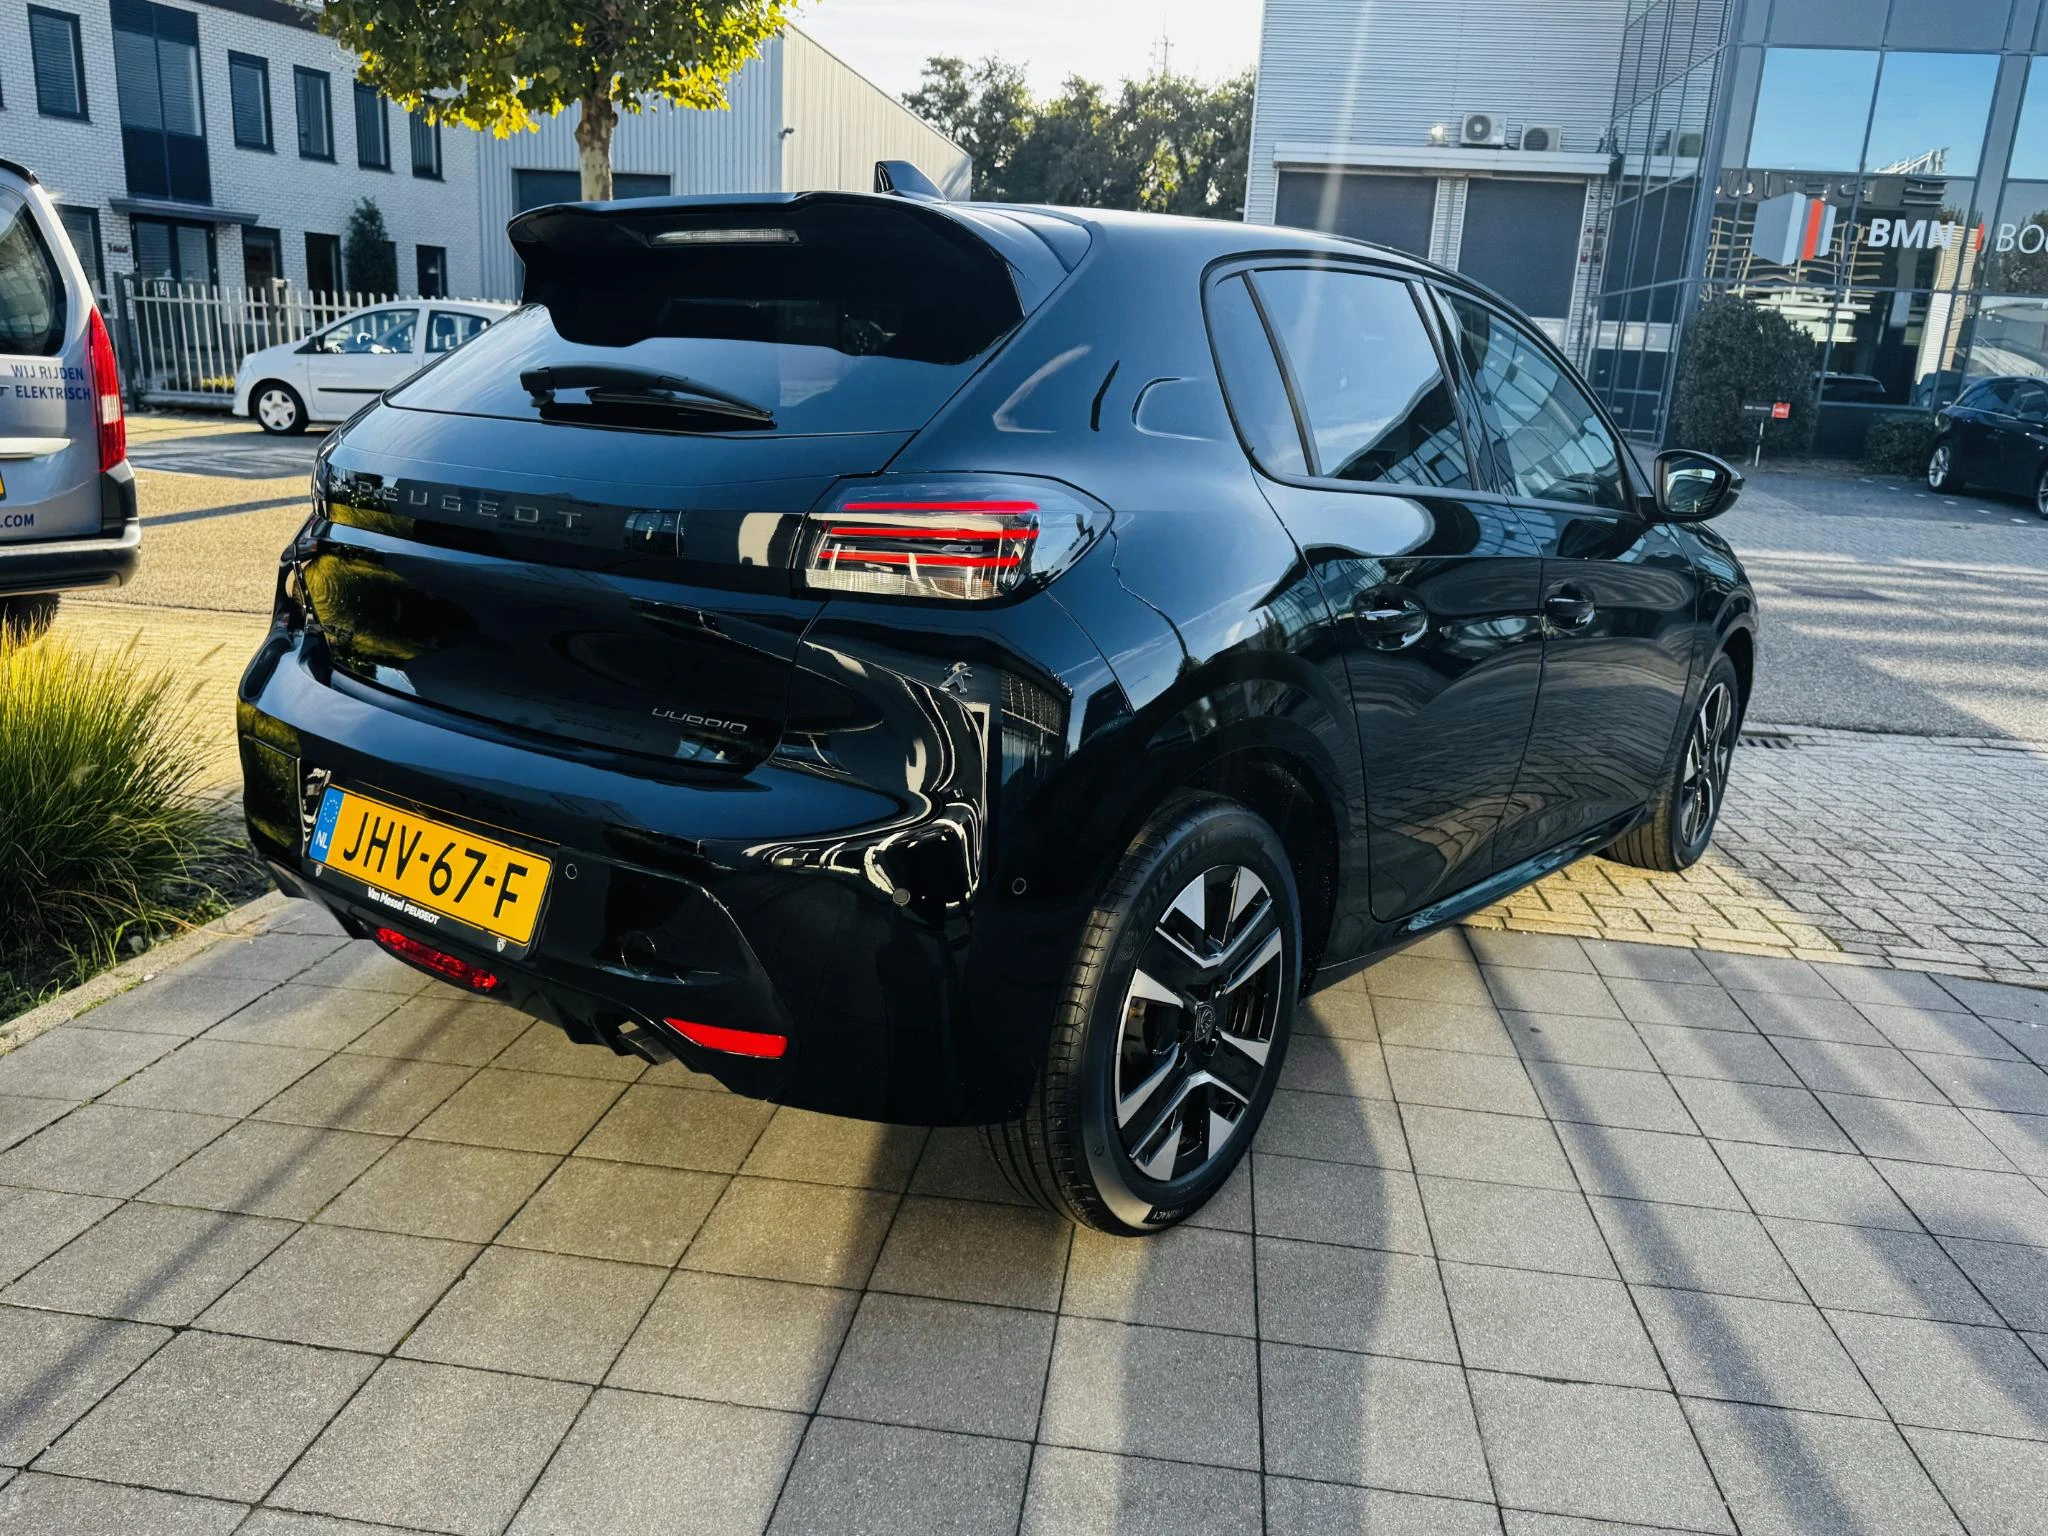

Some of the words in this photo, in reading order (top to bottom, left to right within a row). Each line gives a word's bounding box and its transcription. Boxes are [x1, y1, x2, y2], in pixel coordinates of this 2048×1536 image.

[1868, 218, 1955, 249] BMN
[1996, 223, 2048, 254] BO
[11, 365, 36, 378] WIJ
[40, 366, 84, 380] RIJDEN
[16, 385, 91, 400] ELEKTRISCH
[357, 480, 582, 529] PEUGEOT
[315, 831, 328, 849] NL
[343, 811, 528, 918] JHV-67-F
[367, 886, 381, 901] Van
[380, 892, 405, 911] Mossel
[404, 904, 440, 925] PEUGEOT
